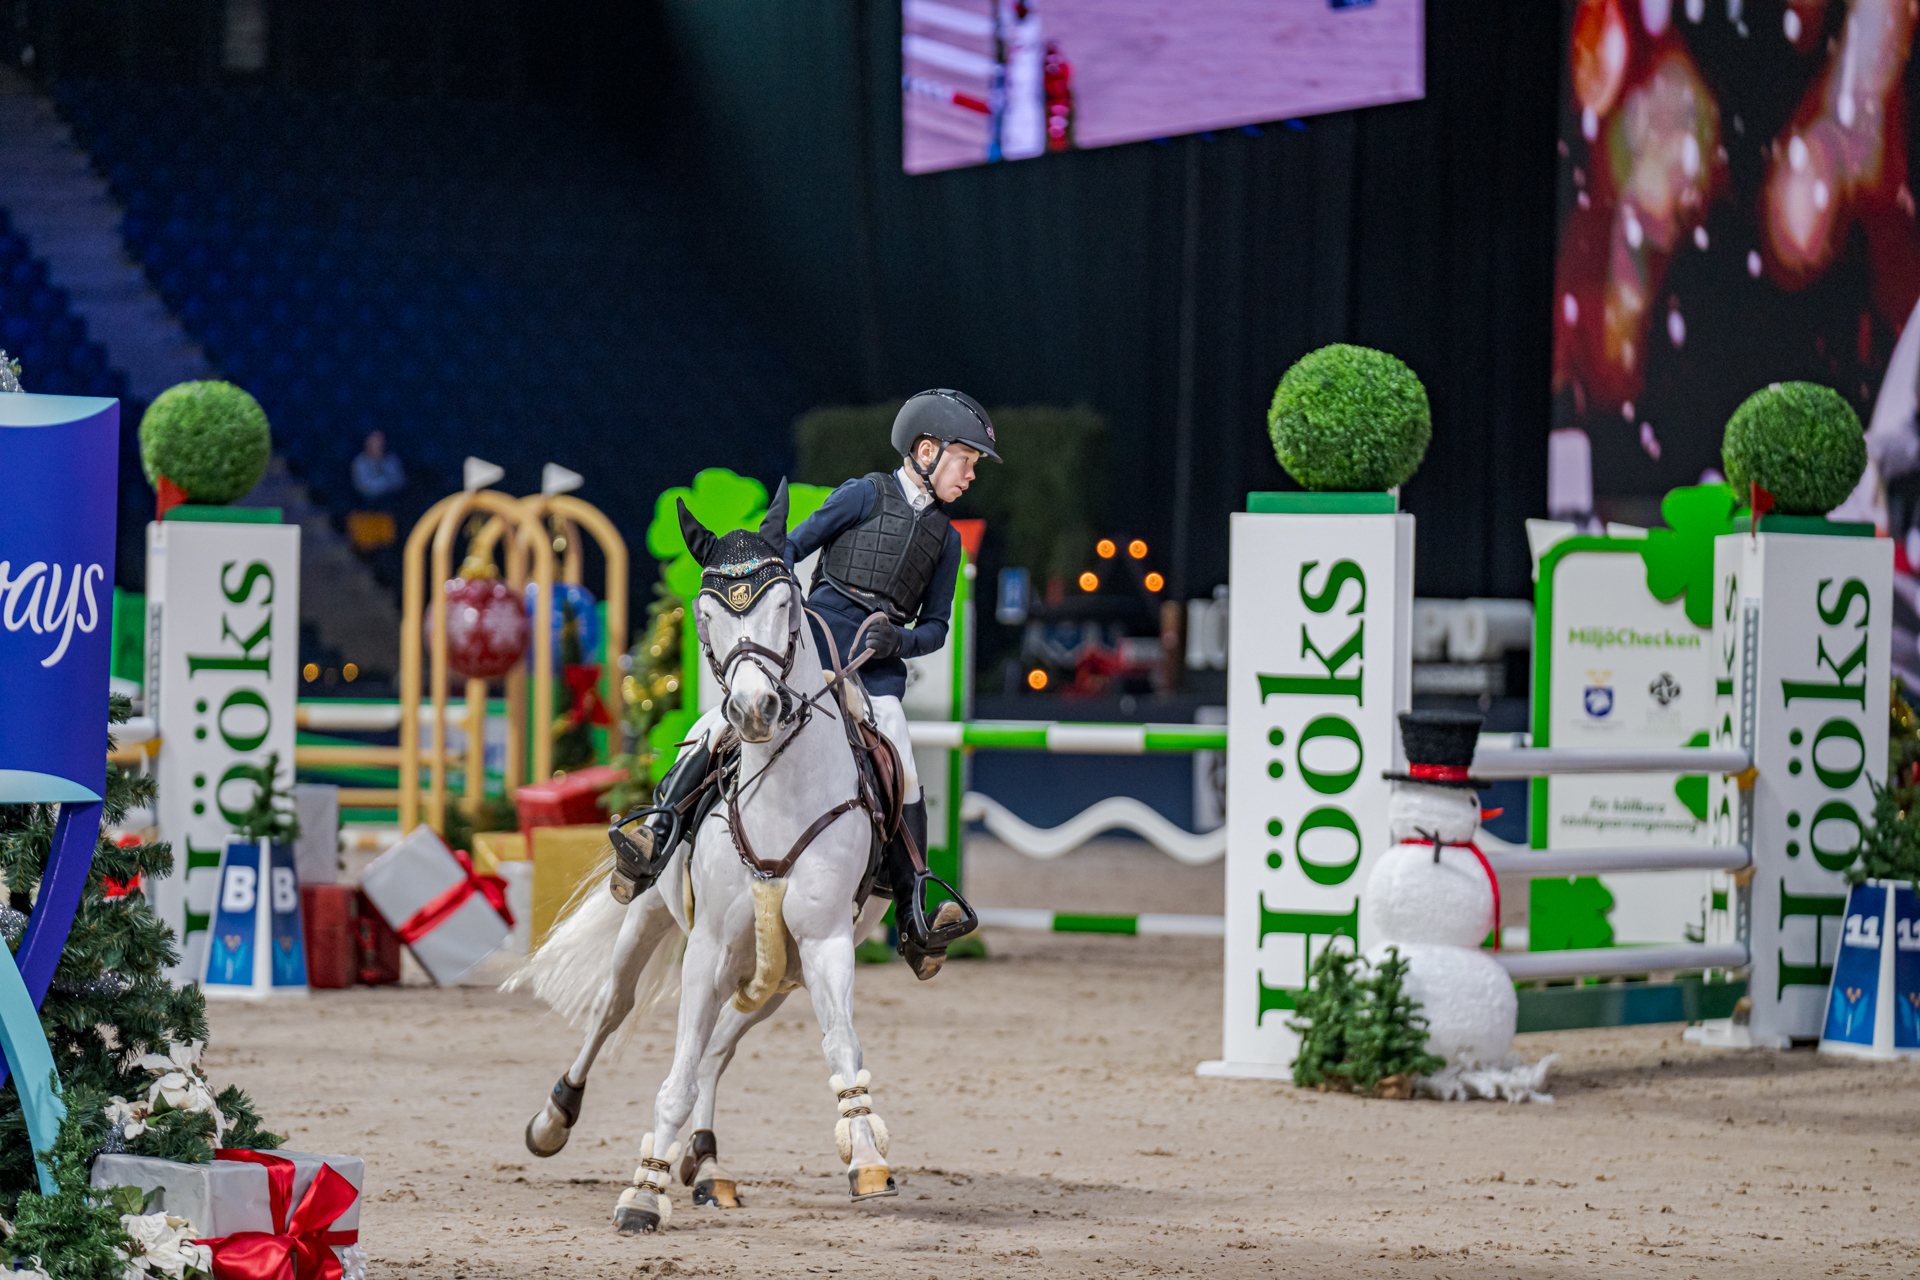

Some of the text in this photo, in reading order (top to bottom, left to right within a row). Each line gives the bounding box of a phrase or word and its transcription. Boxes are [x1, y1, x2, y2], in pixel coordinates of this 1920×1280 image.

[1256, 556, 1367, 1027] Hööks
[1777, 575, 1871, 1003] Hööks
[221, 864, 257, 913] B
[272, 866, 298, 914] B
[1844, 913, 1881, 949] 11
